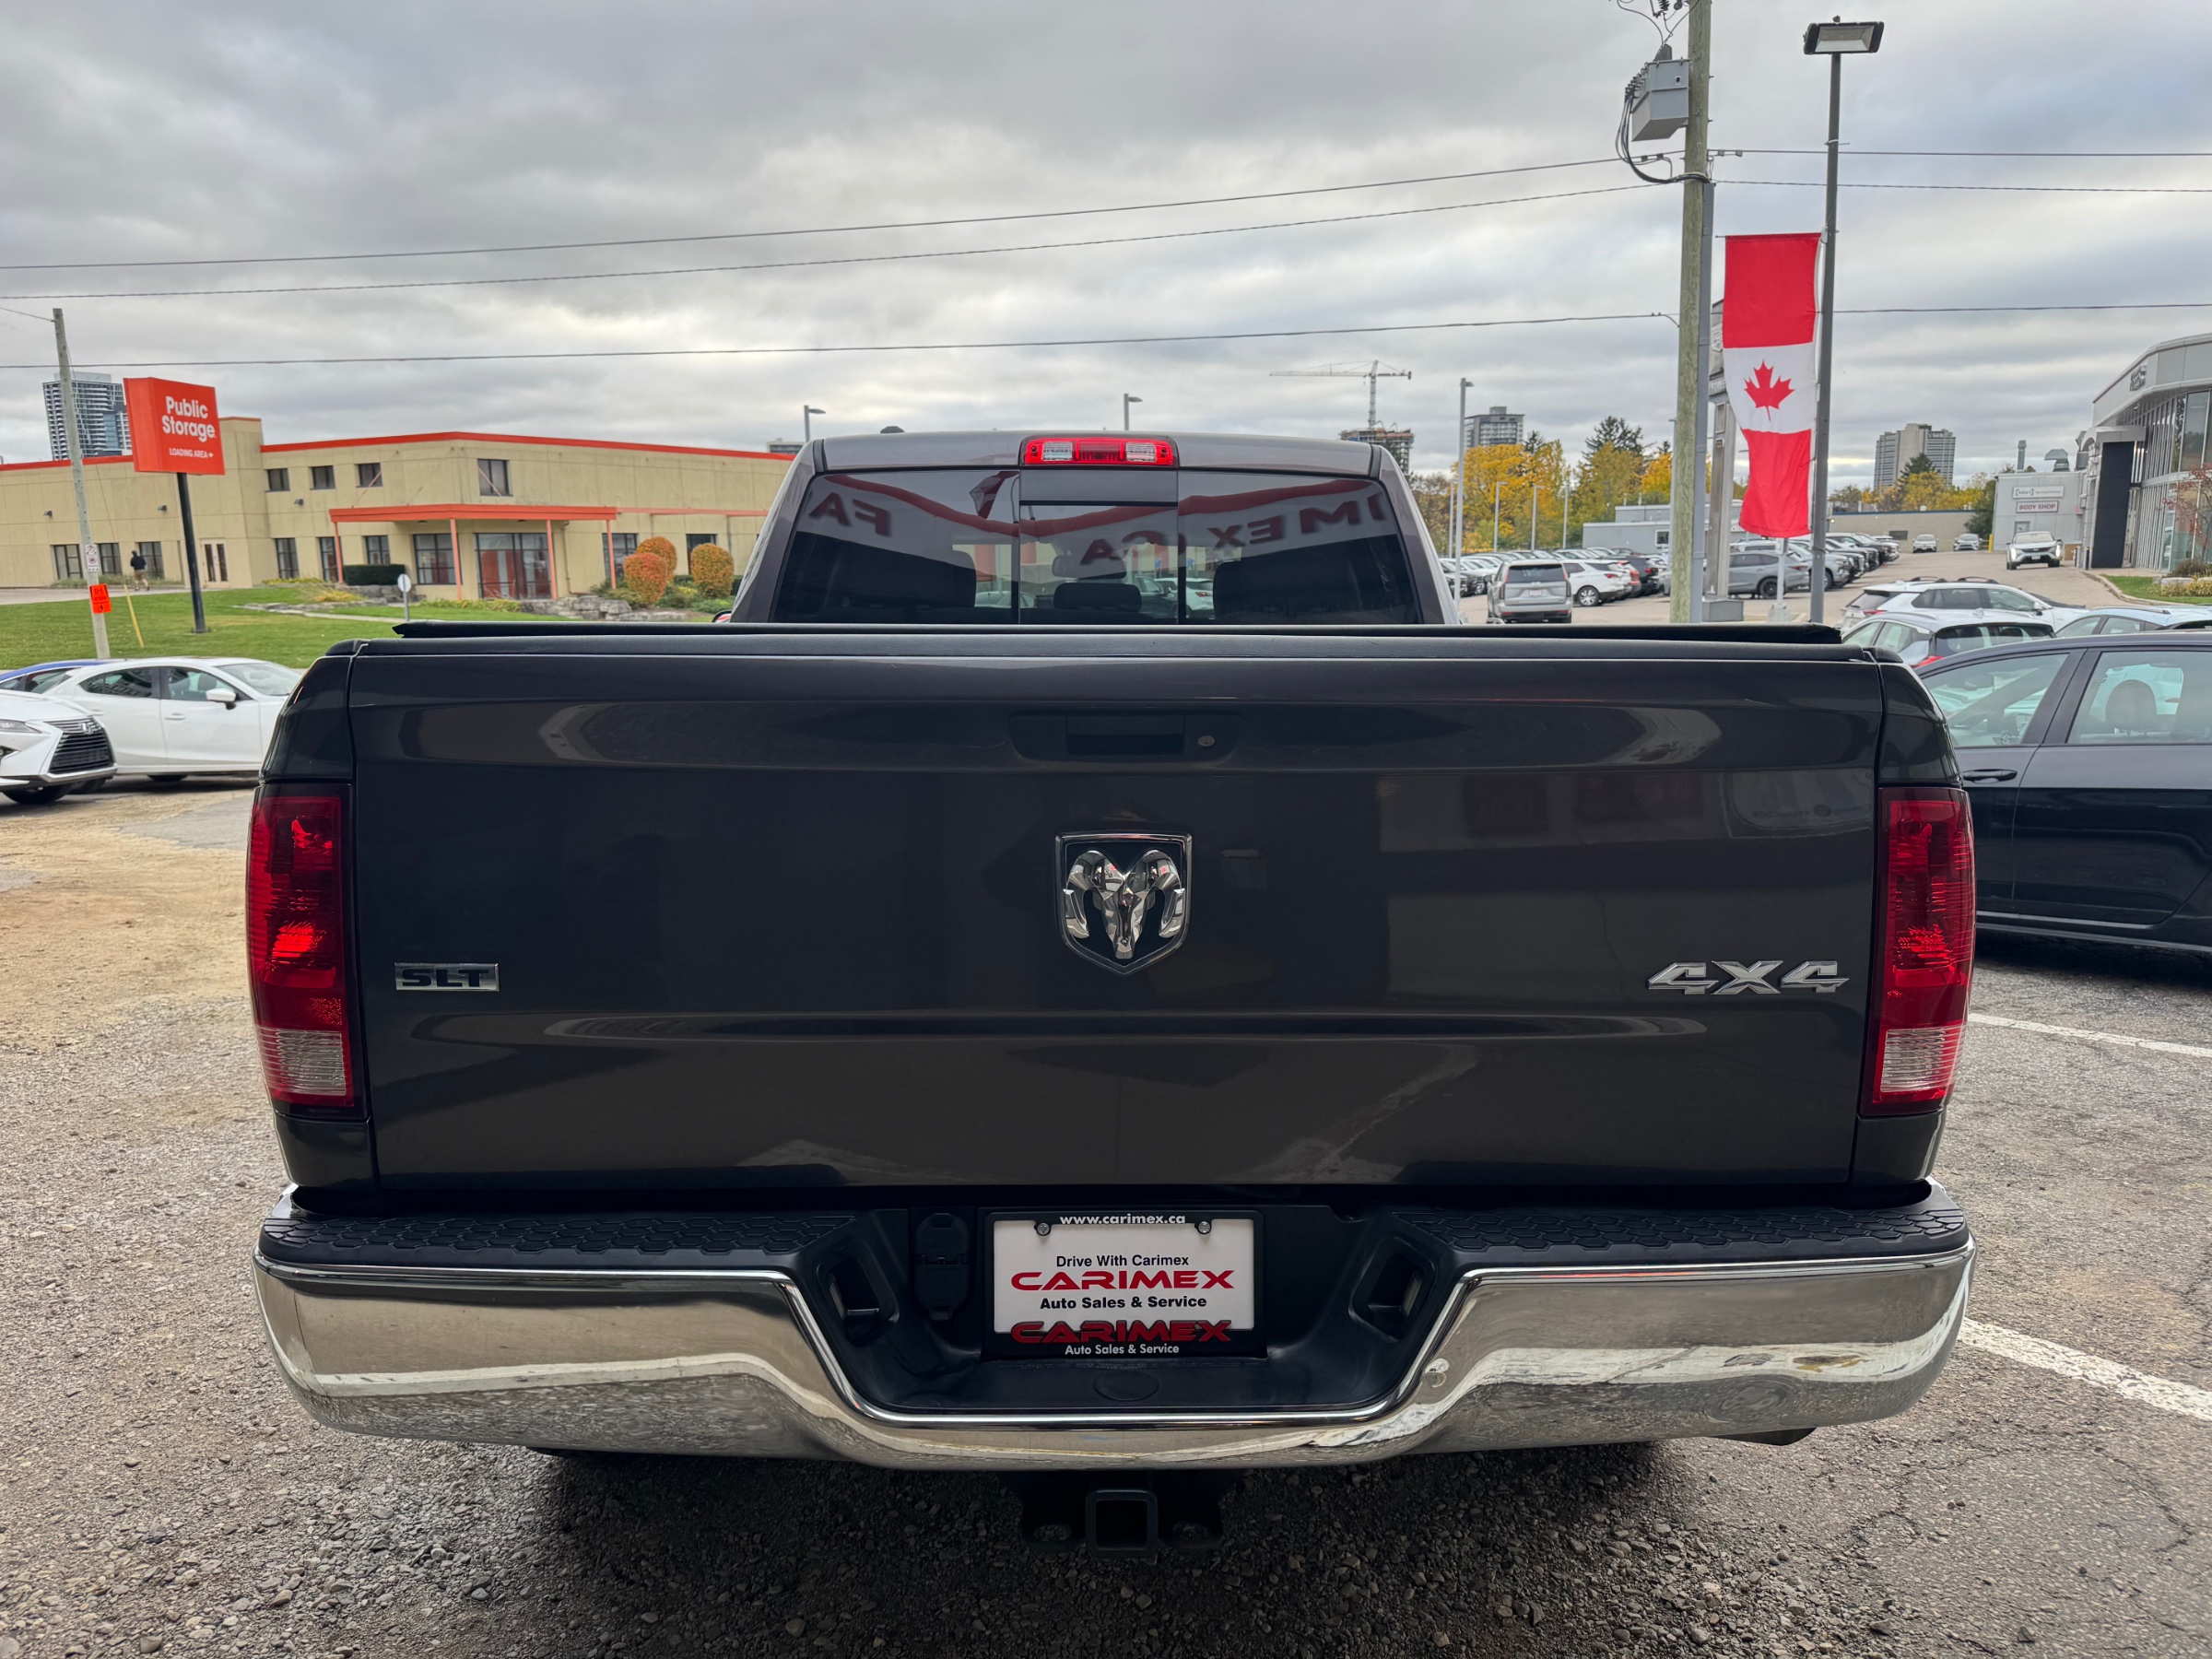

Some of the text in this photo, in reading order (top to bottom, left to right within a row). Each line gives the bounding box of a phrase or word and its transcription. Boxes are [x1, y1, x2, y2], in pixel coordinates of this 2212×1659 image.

[165, 396, 208, 418] Public
[161, 415, 216, 442] Storage
[169, 448, 208, 458] LOADING AREA
[402, 969, 489, 987] SLT
[1647, 960, 1850, 994] 4X4
[1060, 1213, 1185, 1225] www.carimex.ca
[1056, 1254, 1189, 1267] Drive With Carimex
[1011, 1270, 1235, 1290] CARIMEX
[1040, 1296, 1207, 1310] Auto Sales & Service
[1010, 1320, 1232, 1344] CARIMEX
[1065, 1344, 1180, 1356] Auto Sales & Service
